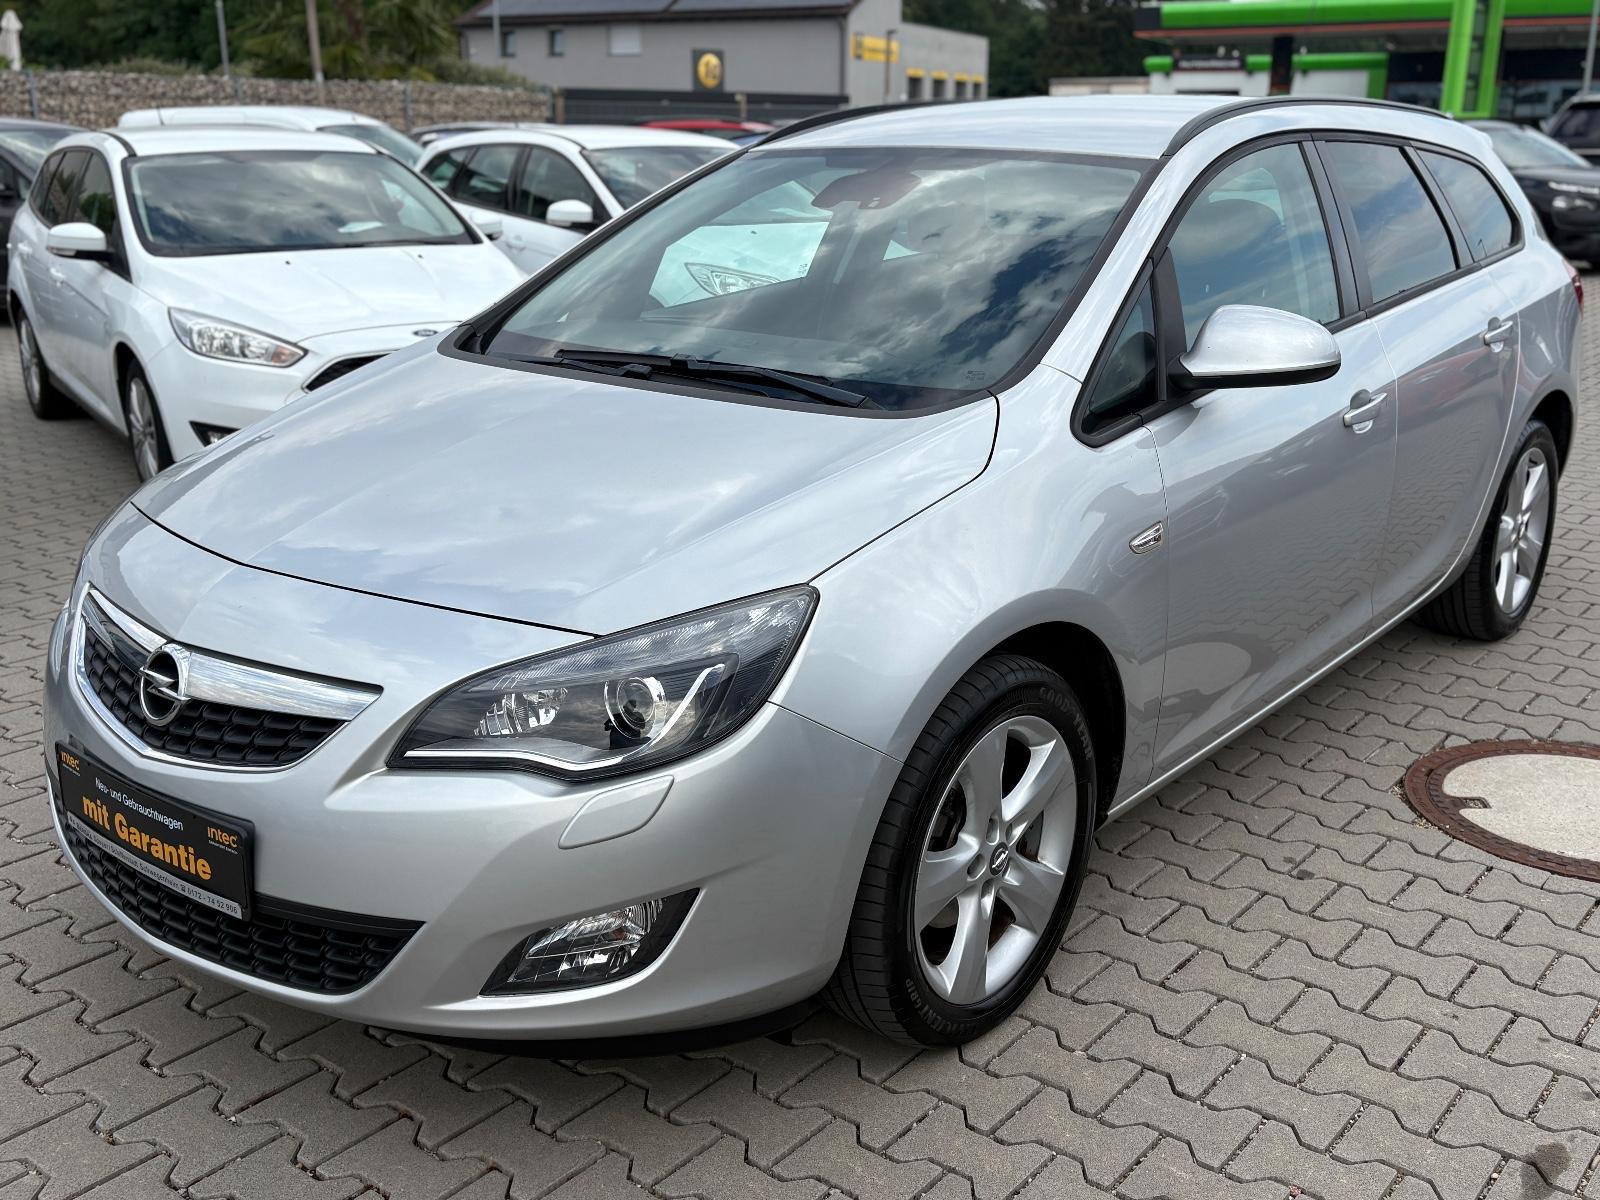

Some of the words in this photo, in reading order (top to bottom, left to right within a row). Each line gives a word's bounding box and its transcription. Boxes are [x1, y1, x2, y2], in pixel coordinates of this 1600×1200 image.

[95, 777, 109, 794] Neu-
[110, 788, 122, 802] und
[122, 793, 184, 831] Gebrauchtwagen
[82, 795, 110, 831] mit
[114, 812, 213, 881] Garantie
[216, 899, 225, 909] 52
[225, 903, 238, 914] 906
